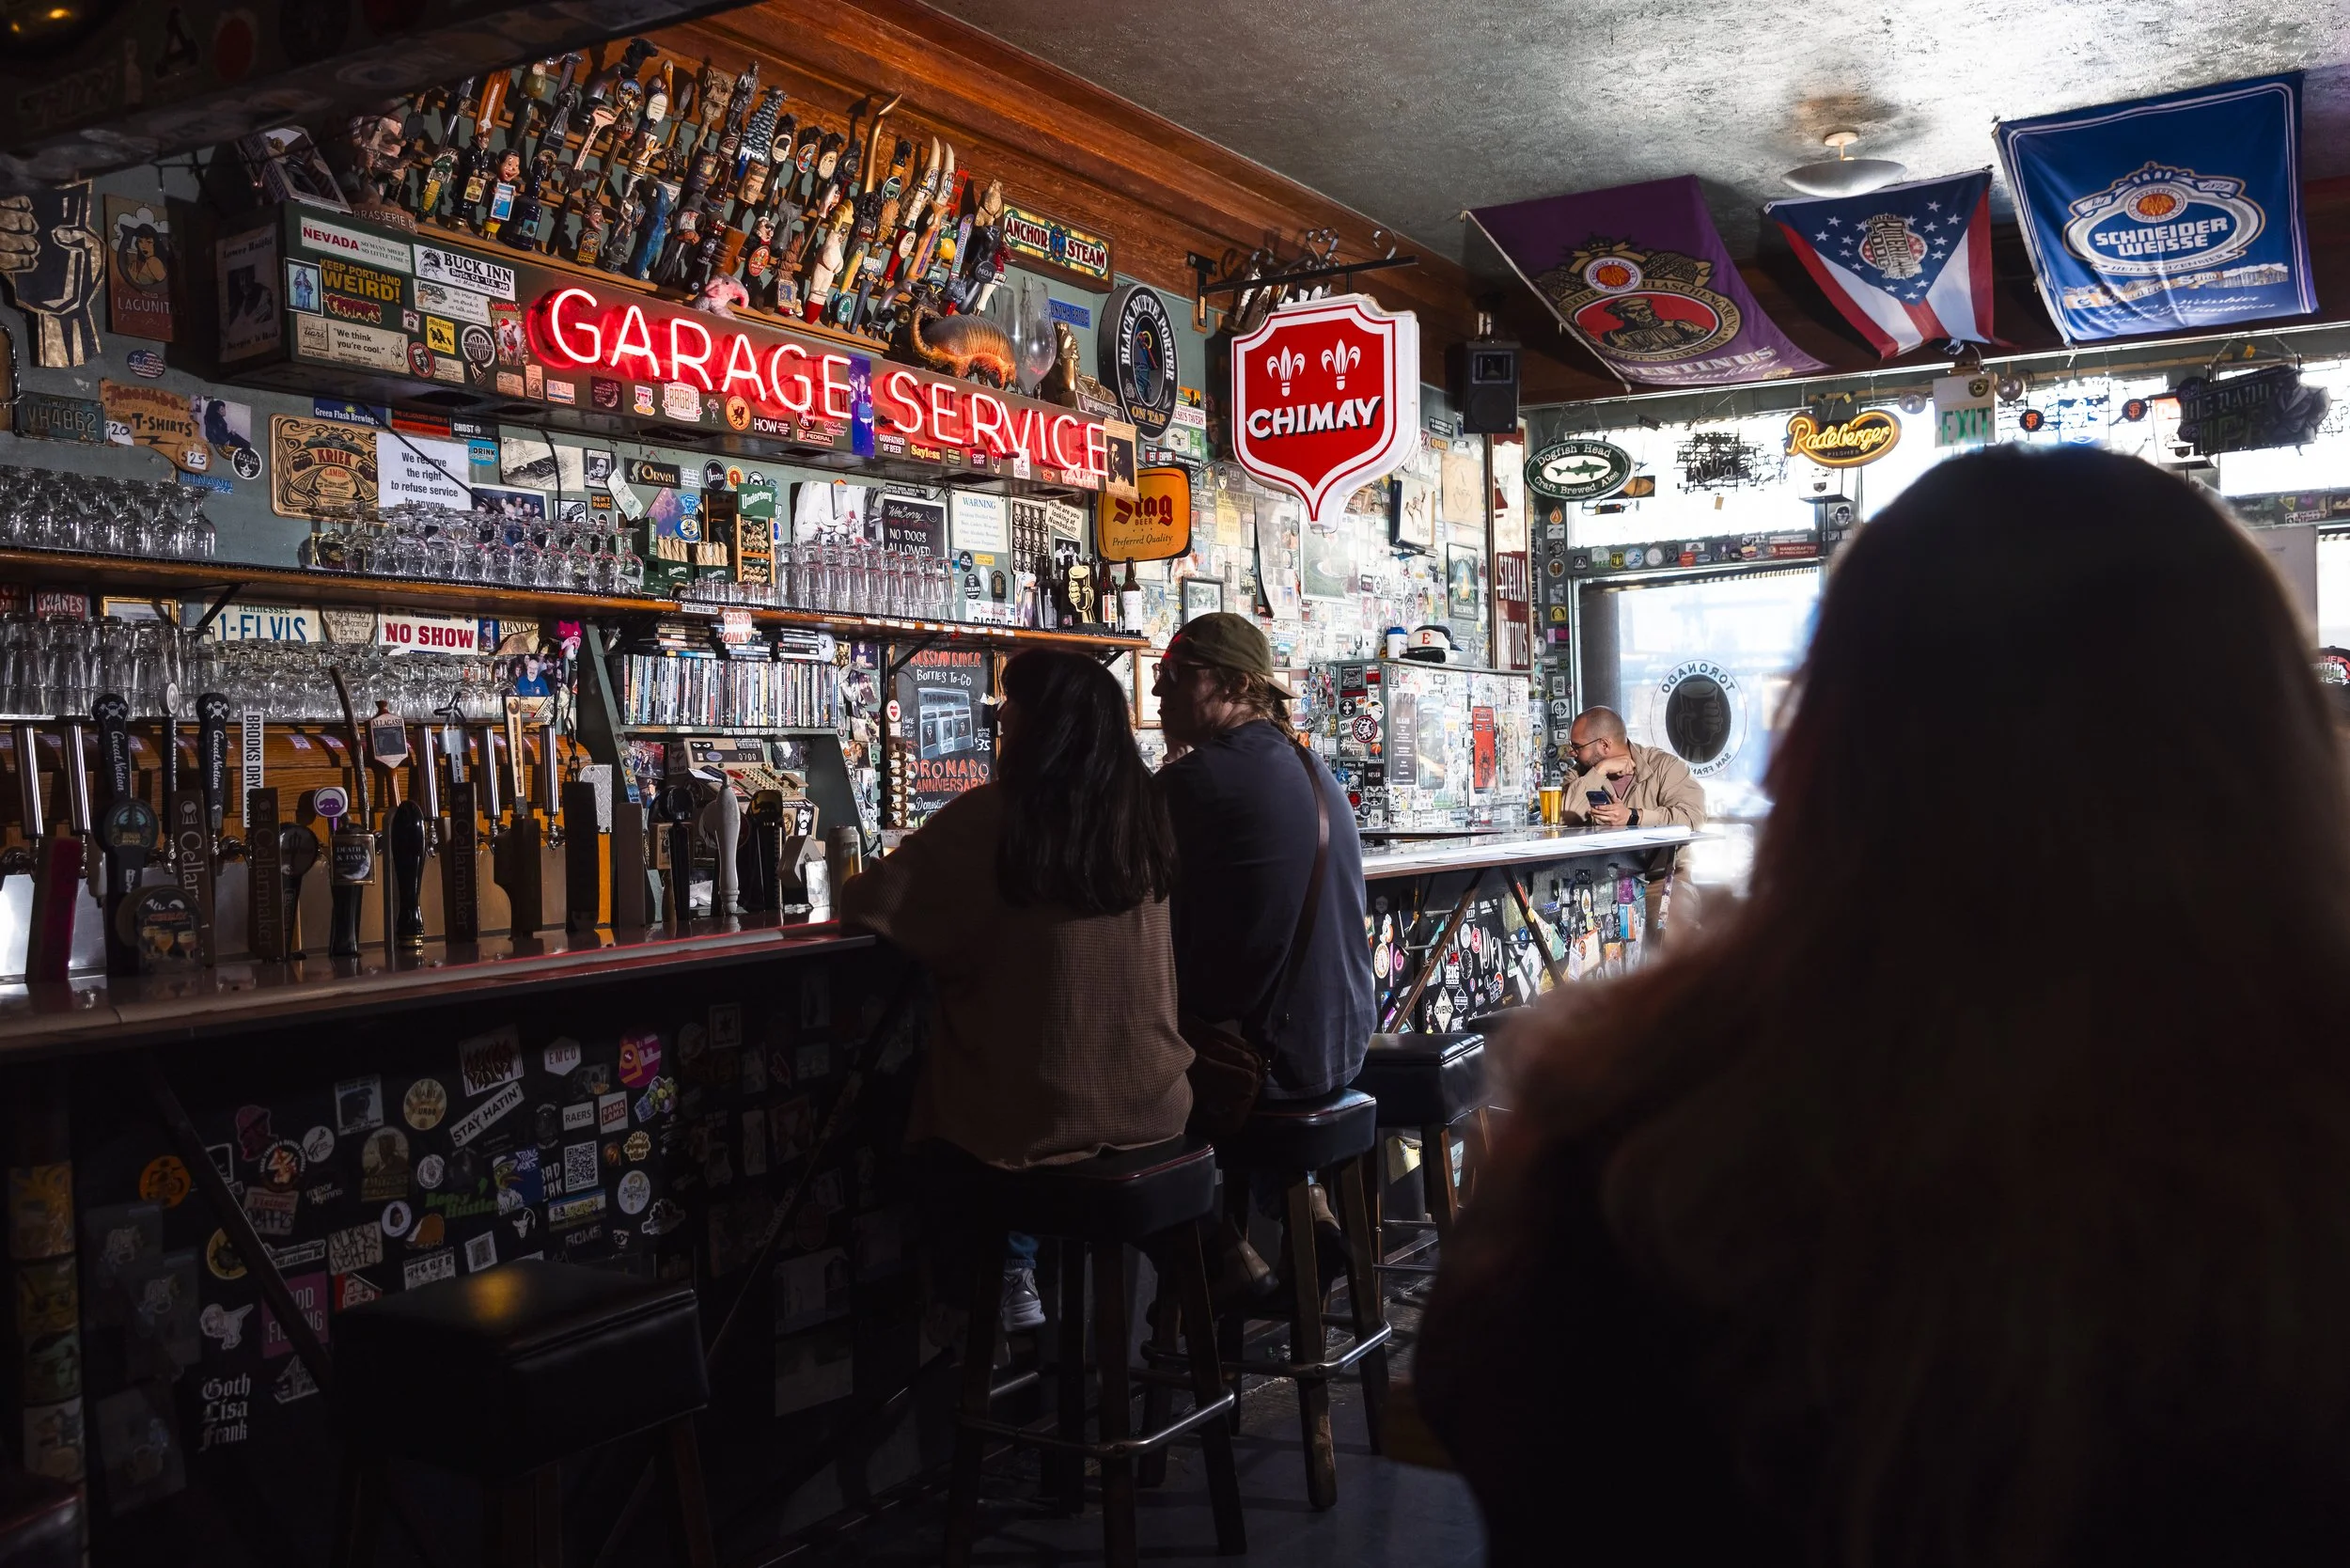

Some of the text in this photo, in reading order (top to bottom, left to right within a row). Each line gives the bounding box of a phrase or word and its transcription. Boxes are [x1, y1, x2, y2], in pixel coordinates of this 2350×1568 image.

[353, 211, 406, 226] BRASSERIE
[304, 227, 359, 250] NEVADA
[2096, 217, 2228, 246] SCHNEIDER
[1005, 217, 1104, 269] ANCHOR STEAM
[2117, 236, 2208, 256] WEISSE
[321, 259, 401, 287] KEEP PORTLAND
[444, 253, 512, 282] BUCK INN
[978, 267, 993, 278] MOA
[321, 269, 400, 305] WEIRD!
[485, 277, 496, 286] U.S.
[499, 280, 509, 290] 395
[352, 331, 371, 342] think
[1120, 295, 1175, 380] BLACK BUTTE PORTER
[337, 340, 361, 351] you're
[551, 288, 853, 419] GARAGE
[669, 387, 695, 408] BAGBY
[26, 404, 97, 433] VH4862
[315, 407, 374, 425] Green Flash Brewing
[890, 370, 1109, 477] SERVICE
[1132, 406, 1146, 419] ON
[1148, 409, 1166, 425] TAP
[1246, 396, 1382, 439] CHIMAY
[132, 413, 194, 437] T-SHIRTS
[454, 423, 474, 432] GHOST
[753, 417, 776, 433] HOW
[1940, 407, 1993, 444] EXIT
[806, 432, 832, 443] FEDERAL
[879, 434, 905, 446] GODFATHER
[1787, 417, 1893, 455] Radeberger
[317, 448, 352, 466] KRIEK
[474, 447, 495, 456] DRINK
[889, 445, 902, 454] BEER
[911, 444, 940, 460] Sayless
[1538, 445, 1611, 467] Dogfish Head
[402, 452, 446, 468] We reserve
[180, 472, 233, 490] HINANO
[324, 468, 348, 478] LAMBIC
[406, 468, 442, 481] the right
[642, 464, 677, 482] ORVAL
[391, 481, 458, 498] to refuse service
[1534, 470, 1620, 495] Craft Brewed Ales
[405, 496, 445, 510] to anyone
[592, 501, 611, 510] PANIC
[742, 491, 773, 509] Underberg
[963, 496, 995, 510] WARNING
[1049, 501, 1060, 510] What
[1071, 510, 1080, 519] you
[1051, 510, 1070, 522] looking
[1113, 494, 1173, 526] Stag
[1048, 517, 1076, 533] Numbskull?
[1135, 517, 1153, 525] BEER
[889, 528, 927, 542] NO DOGS
[1112, 533, 1173, 549] Preferred Quality
[887, 543, 931, 556] ALLOWED
[668, 566, 687, 576] Underberg
[707, 570, 726, 579] Underberg
[1498, 555, 1528, 602] STELLA
[237, 603, 291, 614] Tennessee
[409, 610, 451, 620] Tennessee
[724, 611, 751, 624] CASH
[385, 622, 475, 649] NO SHOW
[499, 621, 540, 634] ARNING
[723, 631, 751, 643] ONLY
[1421, 633, 1431, 645] E
[924, 694, 959, 703] TORONADO
[372, 719, 402, 728] ALLAGASH
[975, 737, 991, 751] $35
[245, 714, 260, 795] BROOKS DRY
[906, 759, 989, 778] ORONADO
[916, 778, 986, 792] ANNIVERSARY
[337, 846, 362, 855] DEATH
[344, 854, 367, 862] TAXES
[454, 815, 470, 929] Cellarmaker
[255, 830, 279, 949] Cellarmaker
[1446, 964, 1460, 980] BIG
[1435, 1005, 1451, 1015] OVENS
[549, 1049, 577, 1065] EMCO
[453, 1086, 519, 1142] STAY HATIN'
[565, 1109, 591, 1122] RAERS
[603, 1102, 625, 1114] RAMA
[603, 1110, 625, 1121] LAMA
[306, 1183, 333, 1198] minor
[311, 1187, 343, 1205] Hymns
[252, 1196, 290, 1208] Visitor
[203, 1372, 251, 1400] Goth
[203, 1400, 248, 1425] Lisa
[197, 1422, 248, 1455] Frank
